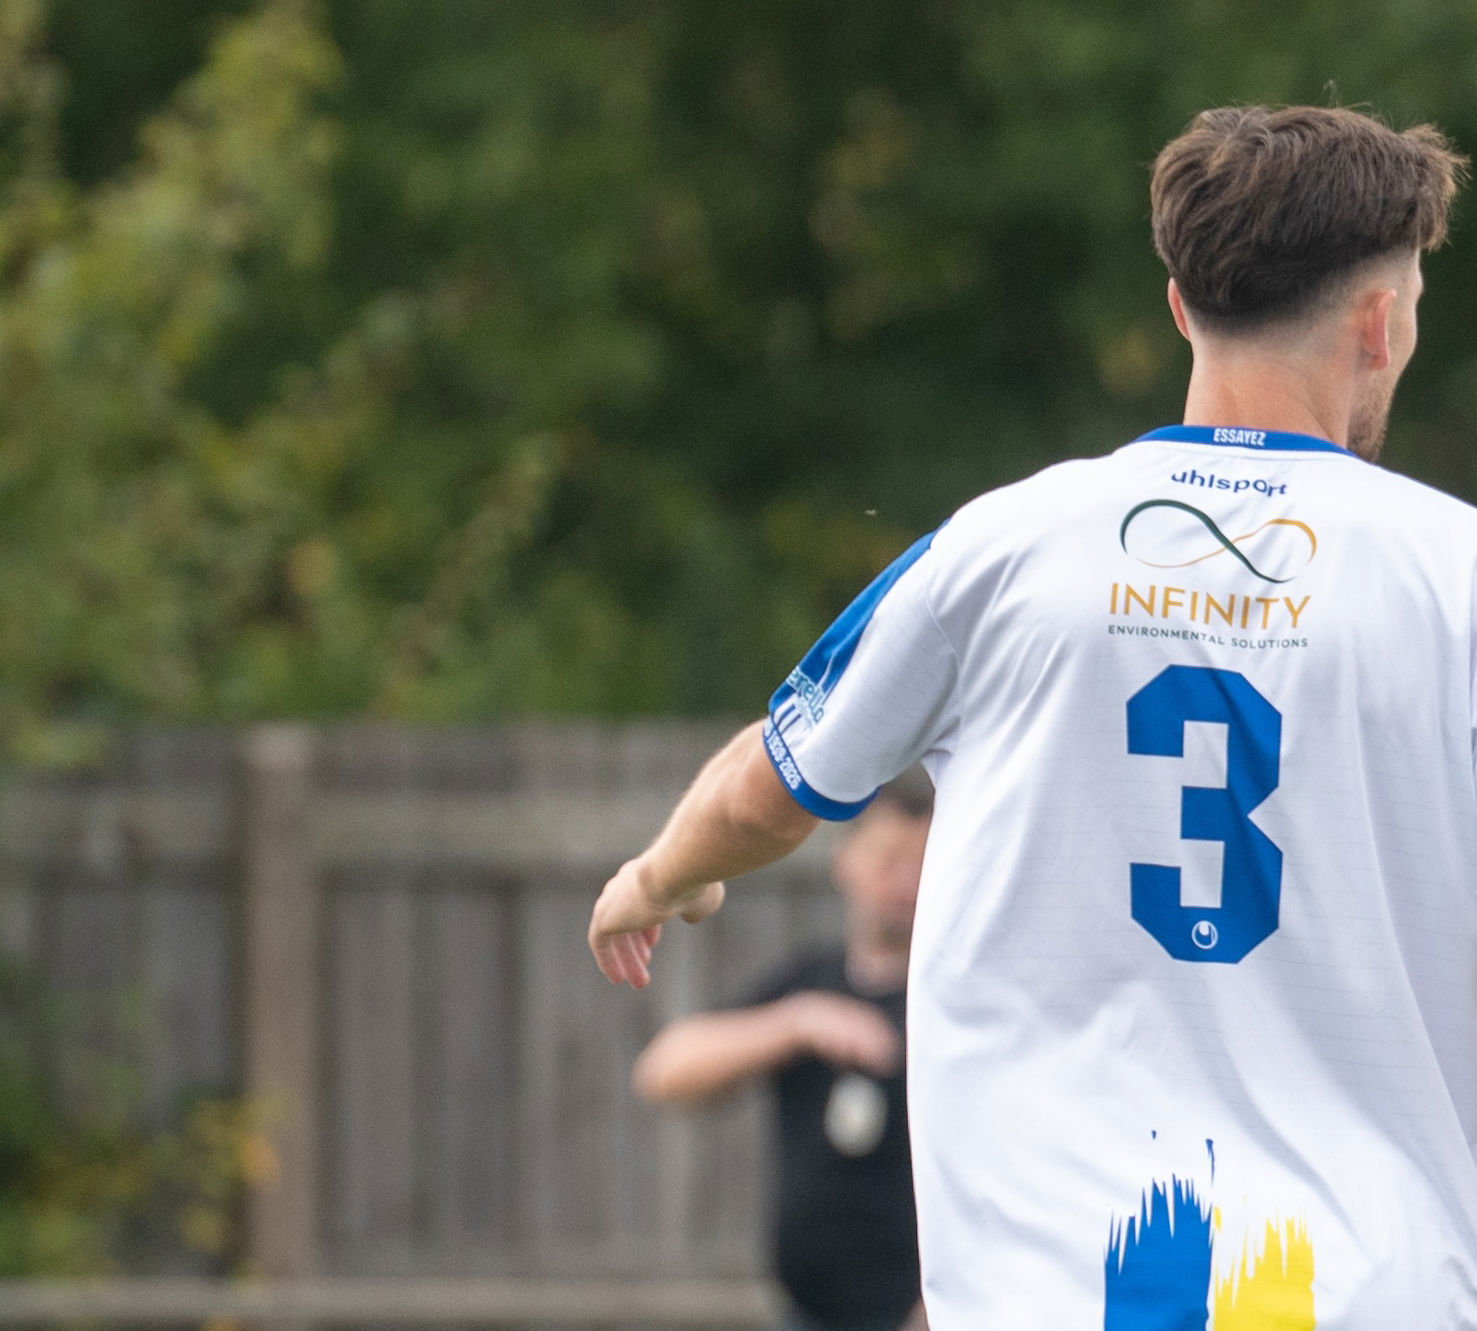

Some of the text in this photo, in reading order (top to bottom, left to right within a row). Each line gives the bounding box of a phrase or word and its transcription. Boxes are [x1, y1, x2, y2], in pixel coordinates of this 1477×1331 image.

[1213, 427, 1267, 446] ESSAYEZ
[1170, 469, 1288, 497] uhlsport
[1109, 582, 1312, 629] INFINITY
[1107, 624, 1309, 648] ENVIRONMENTAL SOLUTIONS
[1126, 664, 1283, 964] 3
